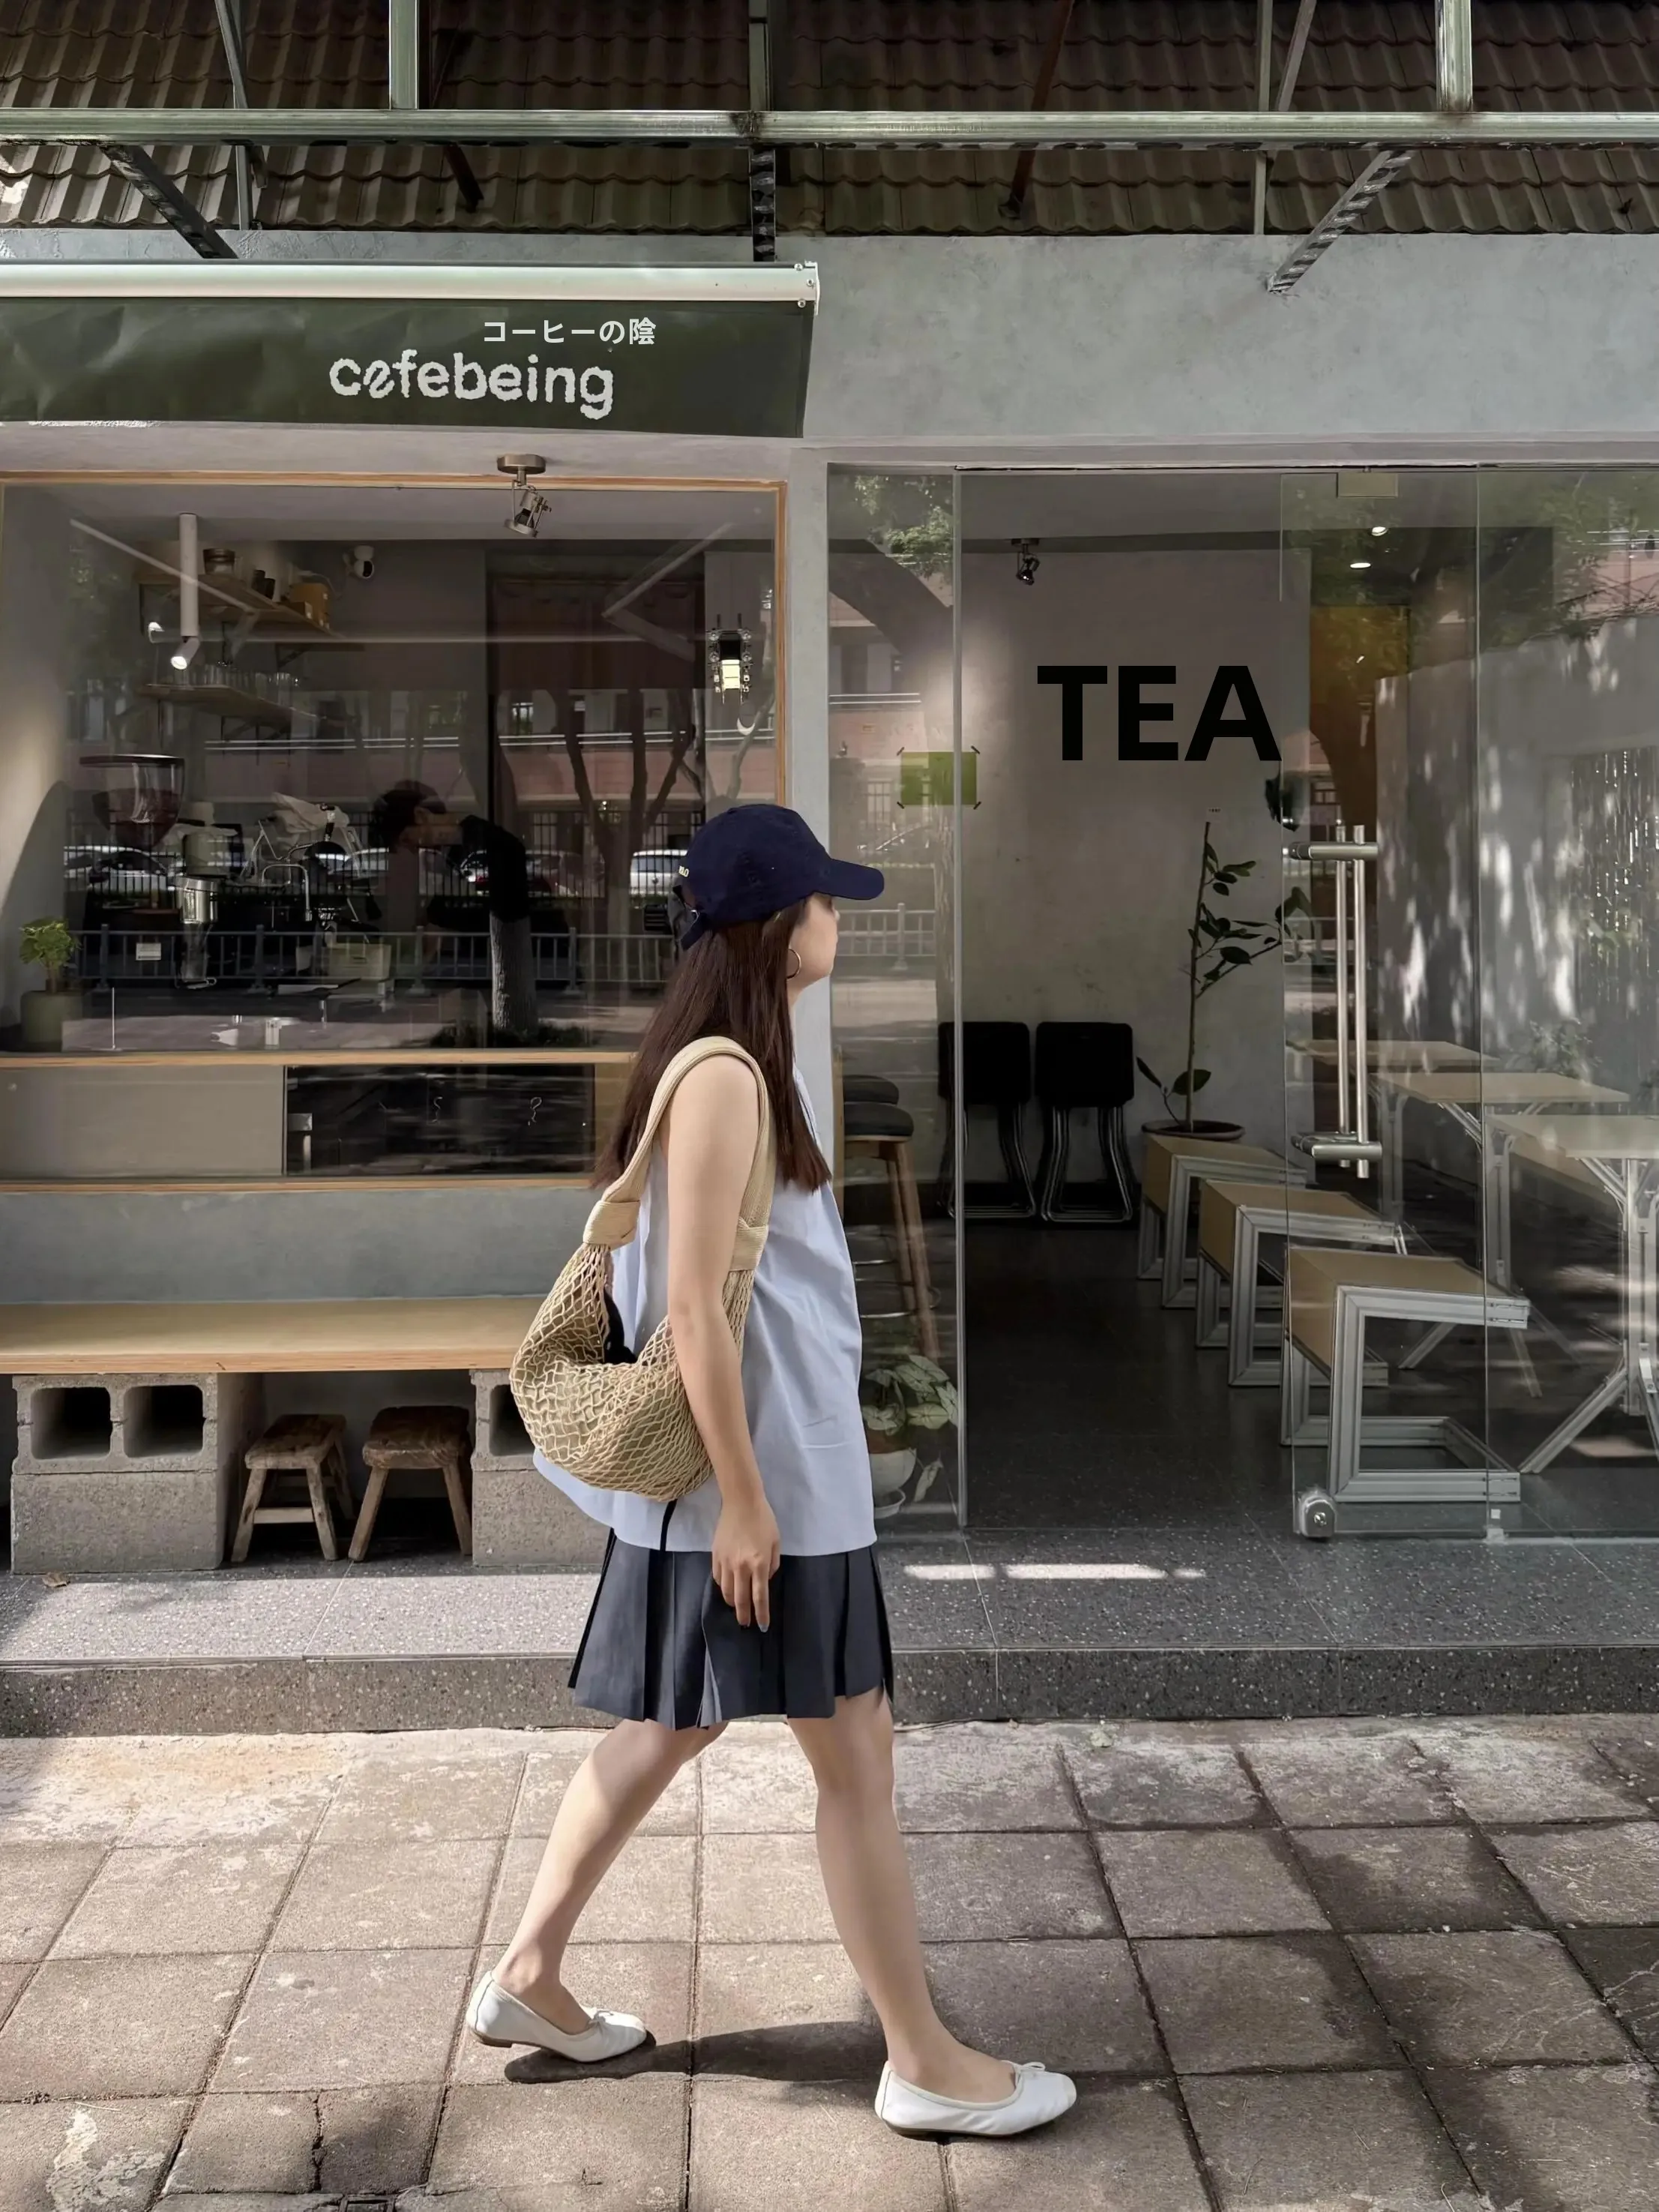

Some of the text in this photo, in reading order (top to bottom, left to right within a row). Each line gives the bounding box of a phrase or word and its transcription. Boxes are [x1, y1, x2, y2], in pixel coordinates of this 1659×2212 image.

[484, 316, 657, 345] コーヒーの陰
[1038, 666, 1282, 761] TEA
